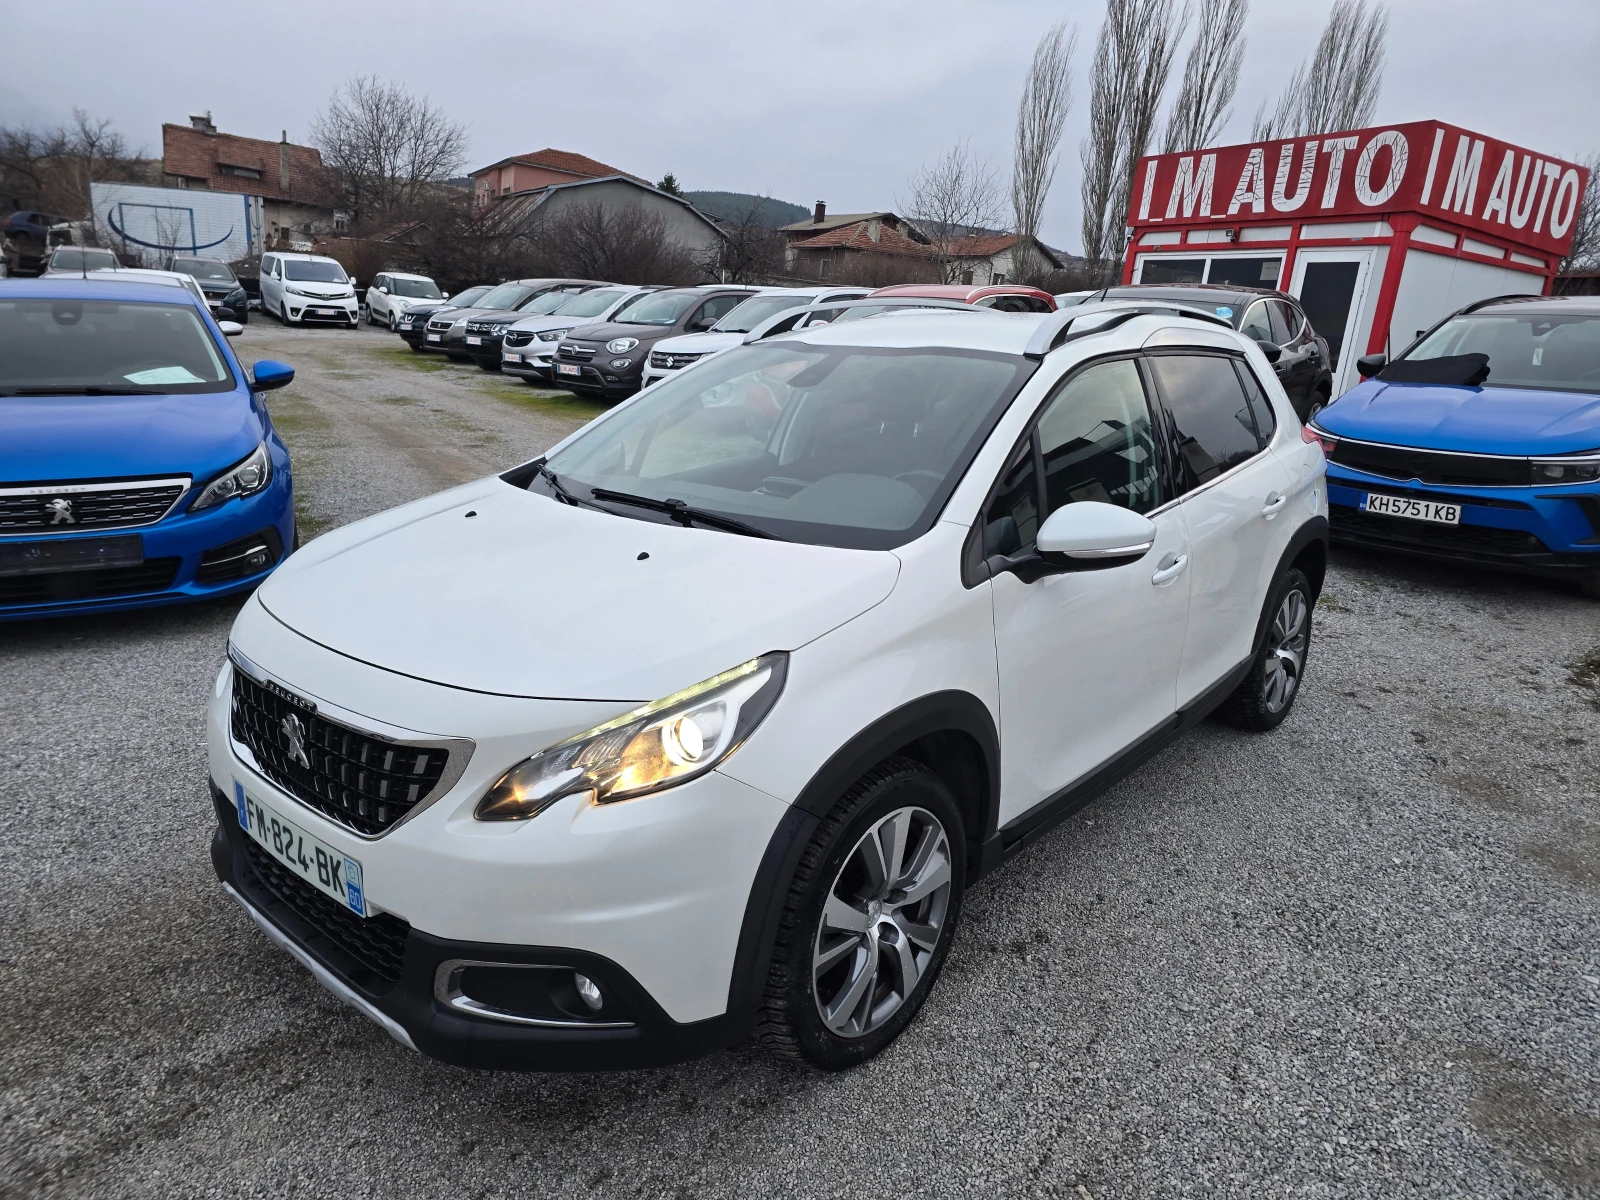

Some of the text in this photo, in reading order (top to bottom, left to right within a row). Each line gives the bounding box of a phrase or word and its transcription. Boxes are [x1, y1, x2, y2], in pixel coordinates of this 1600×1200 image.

[1420, 128, 1580, 240] I M AUTO
[269, 684, 314, 711] PEUGEOT
[245, 795, 346, 898] FM-824-BK
[349, 888, 361, 909] 60
